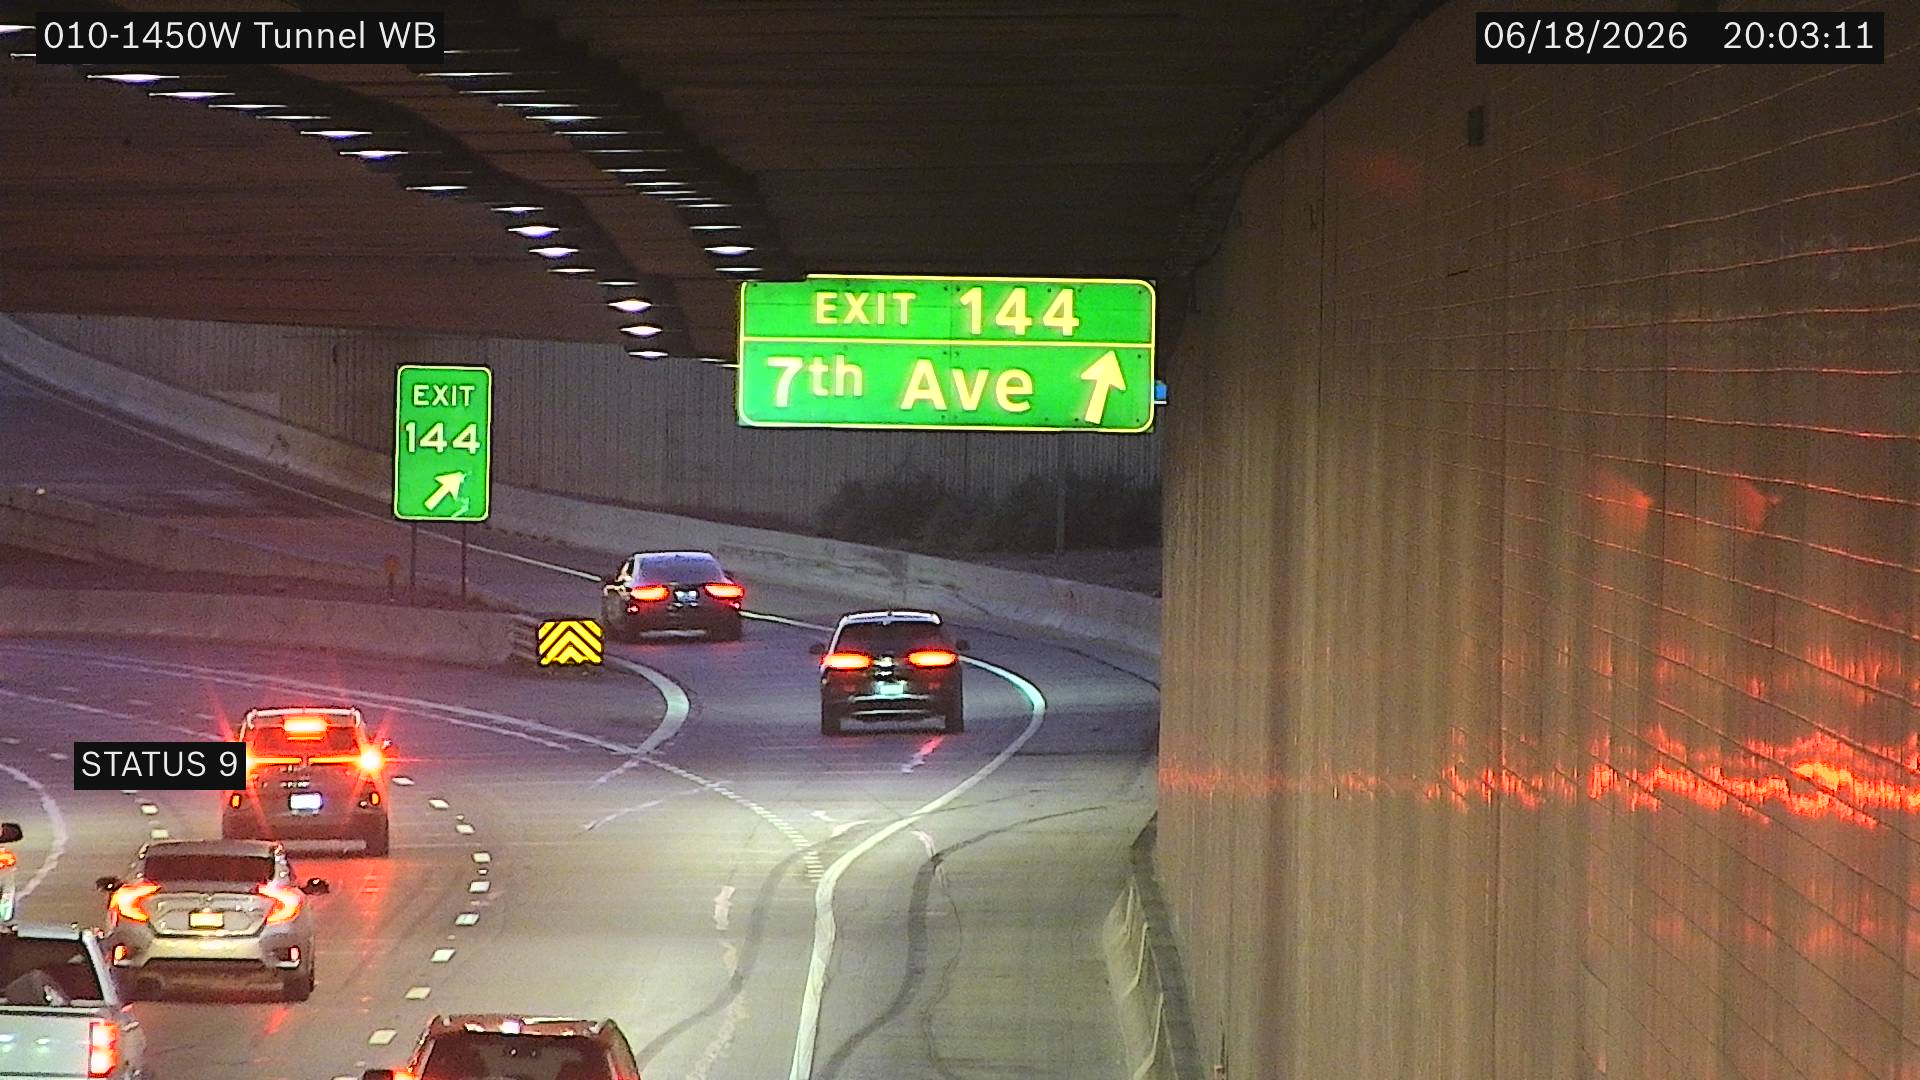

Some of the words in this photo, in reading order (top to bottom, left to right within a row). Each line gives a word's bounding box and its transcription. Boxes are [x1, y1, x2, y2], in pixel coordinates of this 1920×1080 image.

[815, 291, 916, 326] EXIT
[959, 287, 1080, 337] 144
[413, 384, 475, 407] EXIT
[767, 354, 863, 408] 7th
[900, 358, 1033, 412] Ave
[405, 421, 481, 455] 144
